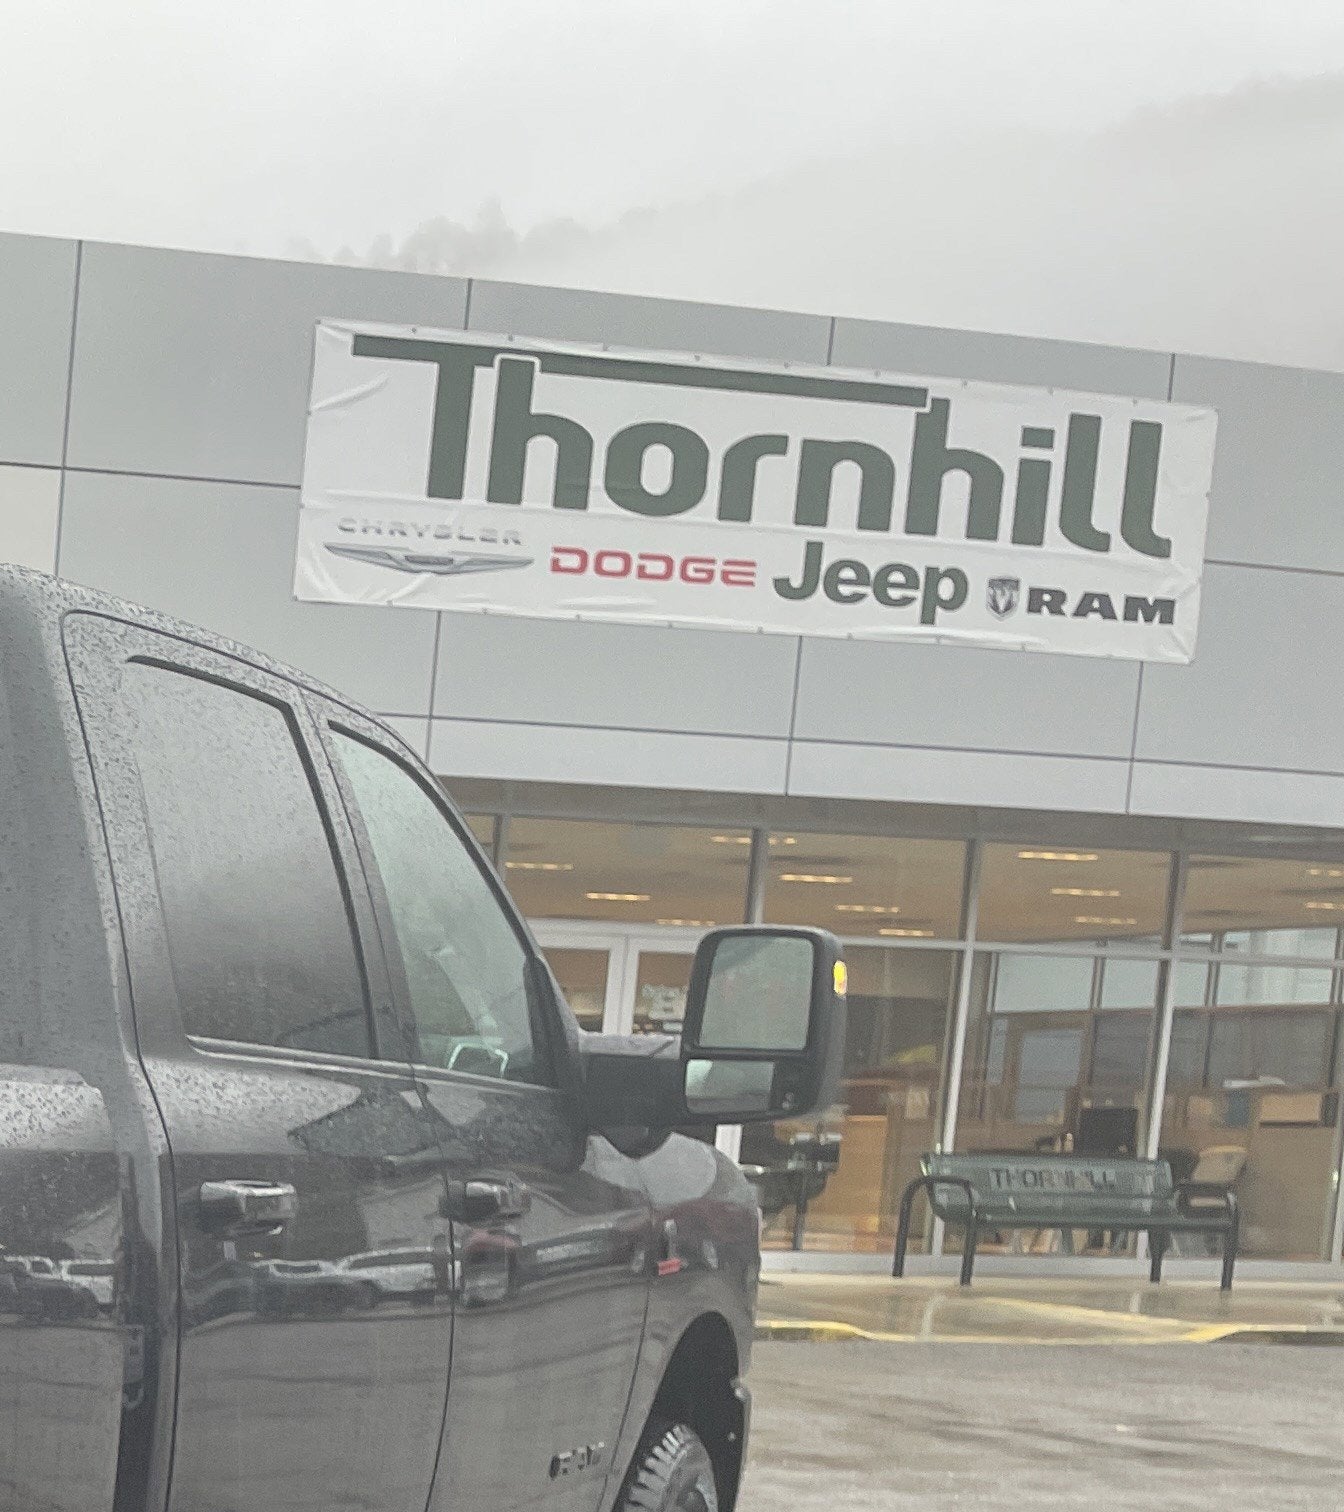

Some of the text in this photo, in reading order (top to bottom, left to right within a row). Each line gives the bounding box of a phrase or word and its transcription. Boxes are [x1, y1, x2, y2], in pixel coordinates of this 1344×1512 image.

[352, 333, 1173, 558] Thornhill
[337, 517, 523, 546] CHRYSLER
[550, 545, 757, 588] DODGE
[773, 541, 969, 625] Jeep
[1027, 586, 1176, 625] RAM
